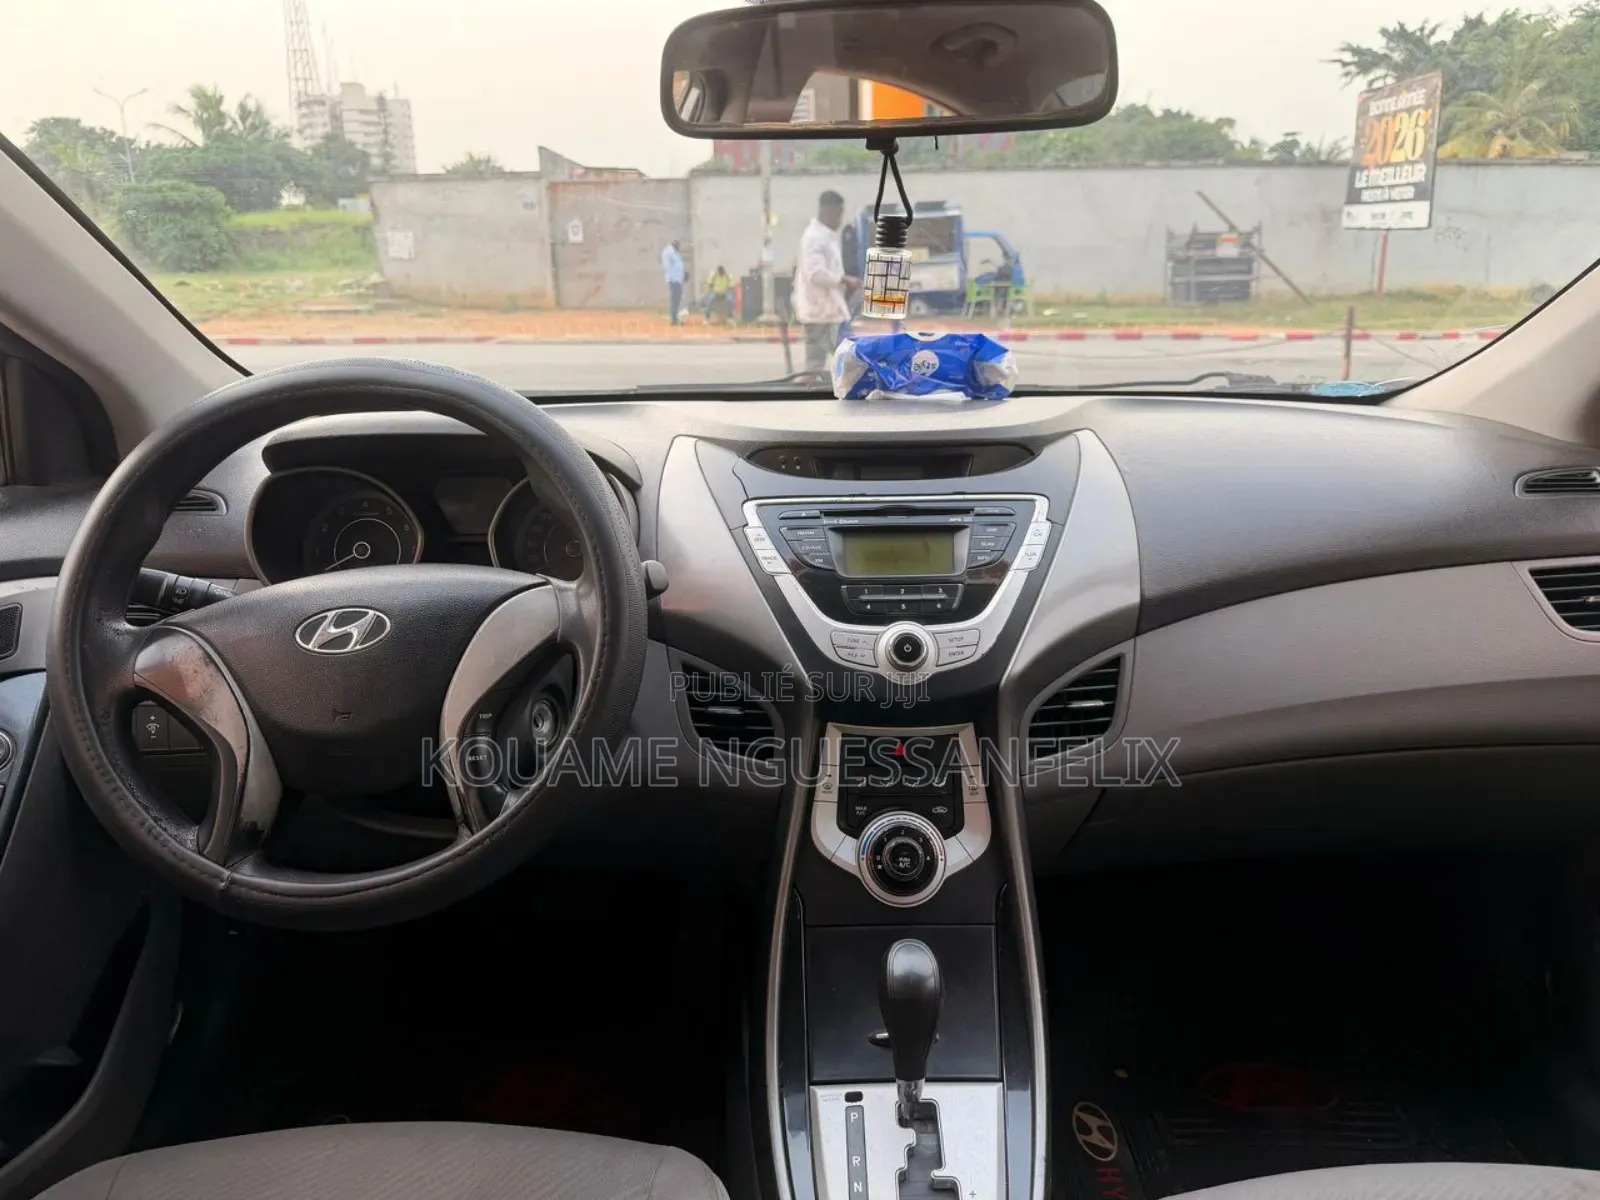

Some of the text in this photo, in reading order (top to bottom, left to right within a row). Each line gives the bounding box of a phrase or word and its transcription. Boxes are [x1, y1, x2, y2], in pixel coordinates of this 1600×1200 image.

[1361, 109, 1426, 166] 2026
[1354, 163, 1427, 188] LE MEILLEUR
[850, 1112, 859, 1122] P
[852, 1156, 861, 1166] R
[853, 1182, 862, 1192] N
